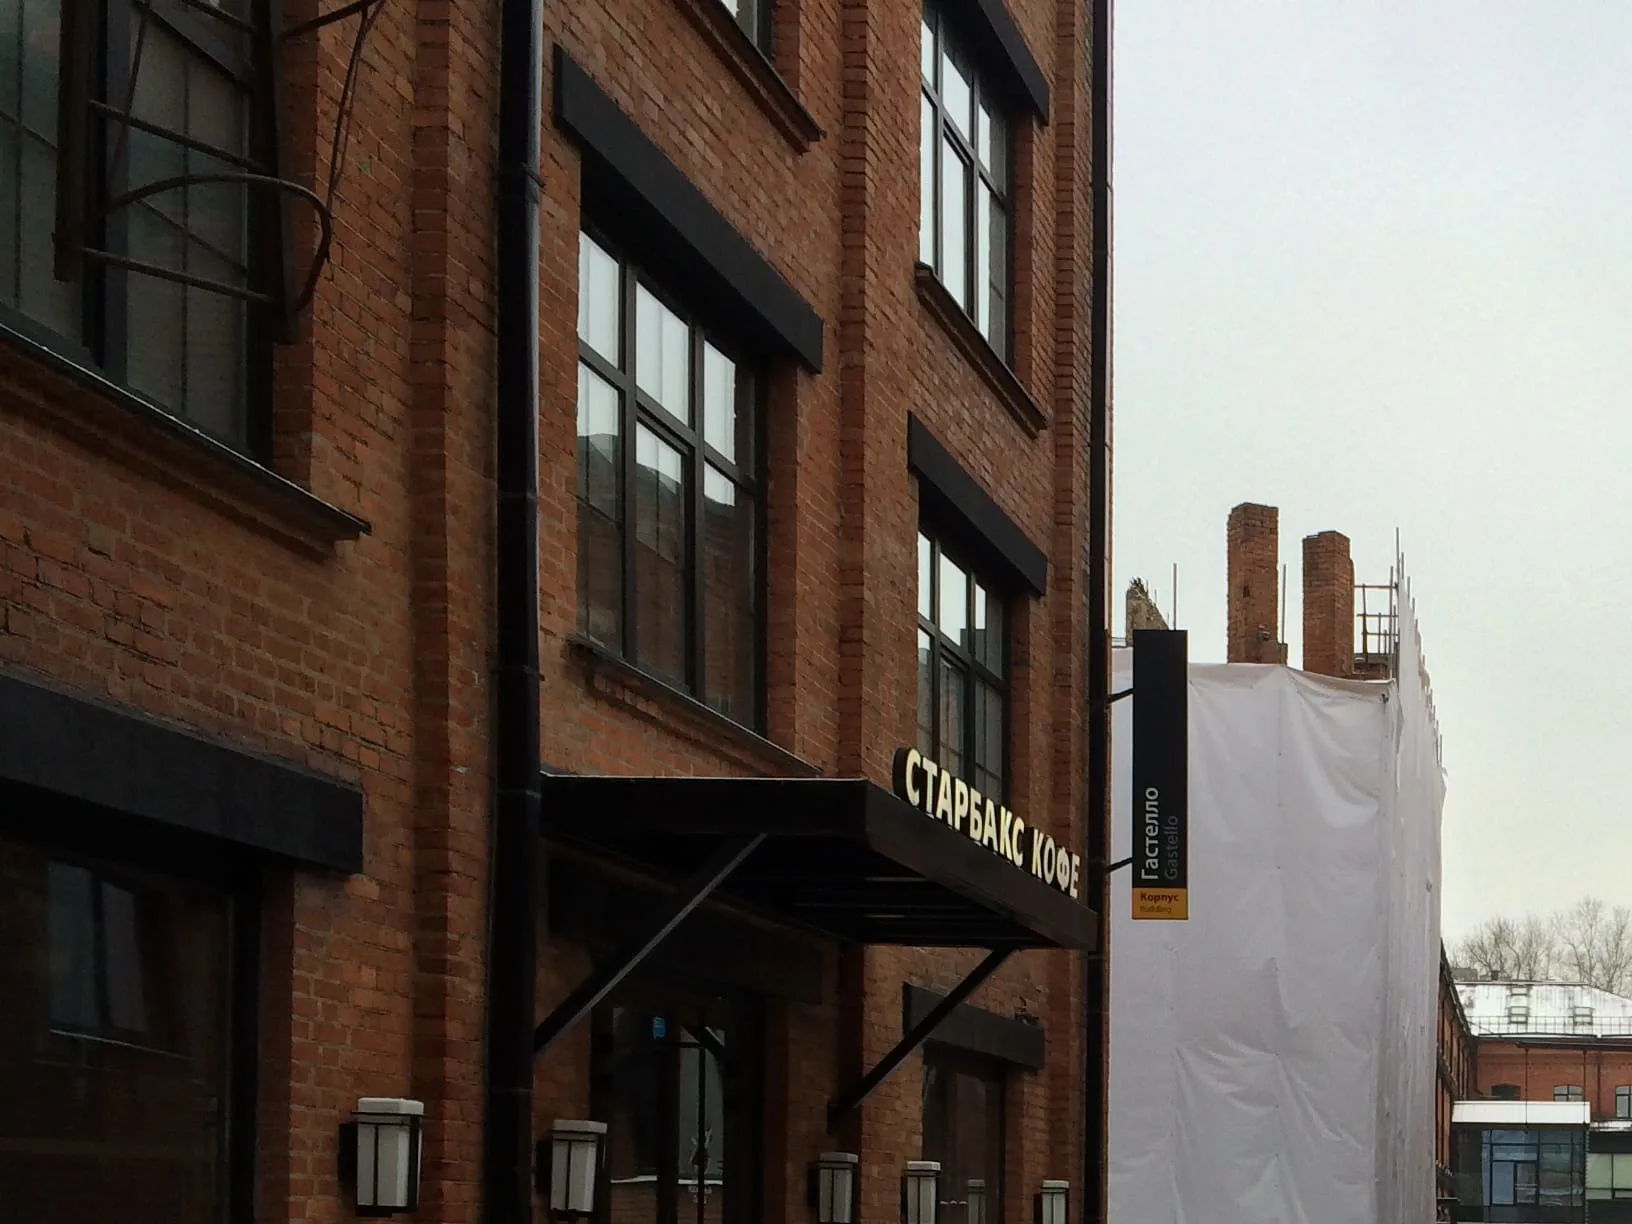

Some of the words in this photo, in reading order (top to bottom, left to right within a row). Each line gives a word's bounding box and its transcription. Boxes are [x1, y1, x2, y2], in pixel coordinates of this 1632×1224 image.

[905, 747, 1025, 868] СТАРБАКС
[1031, 827, 1081, 899] КОФЕ
[1141, 786, 1159, 880] Гастелло
[1164, 815, 1178, 880] Gastello
[1140, 891, 1180, 904] Корпус
